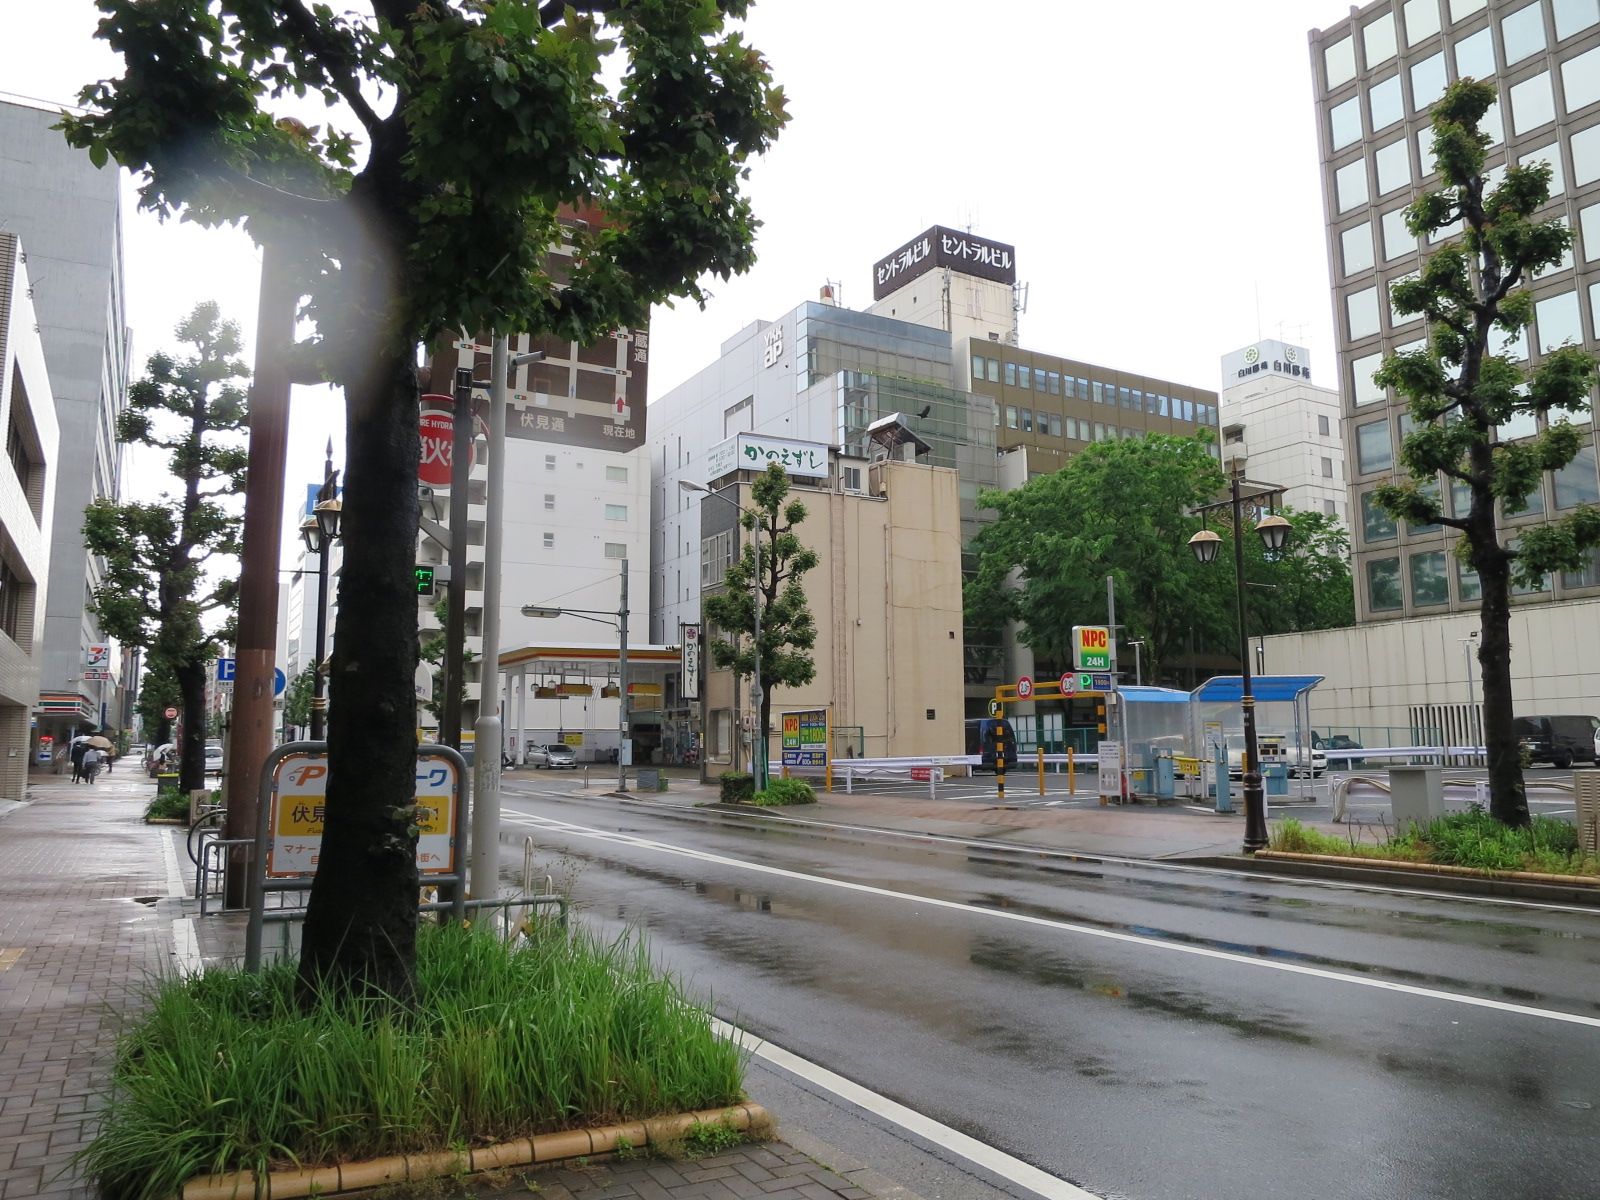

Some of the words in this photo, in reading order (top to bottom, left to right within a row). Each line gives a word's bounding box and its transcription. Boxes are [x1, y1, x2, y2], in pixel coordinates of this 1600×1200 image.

[877, 237, 931, 285] セントラルビル
[941, 234, 1012, 270] セントラルビル
[764, 324, 783, 347] YKK
[519, 412, 565, 433] 伏見通
[602, 424, 636, 439] 現在地
[1081, 629, 1107, 648] NPC
[1086, 656, 1104, 667] 24H
[784, 718, 798, 732] NPC
[786, 738, 797, 746] 24H
